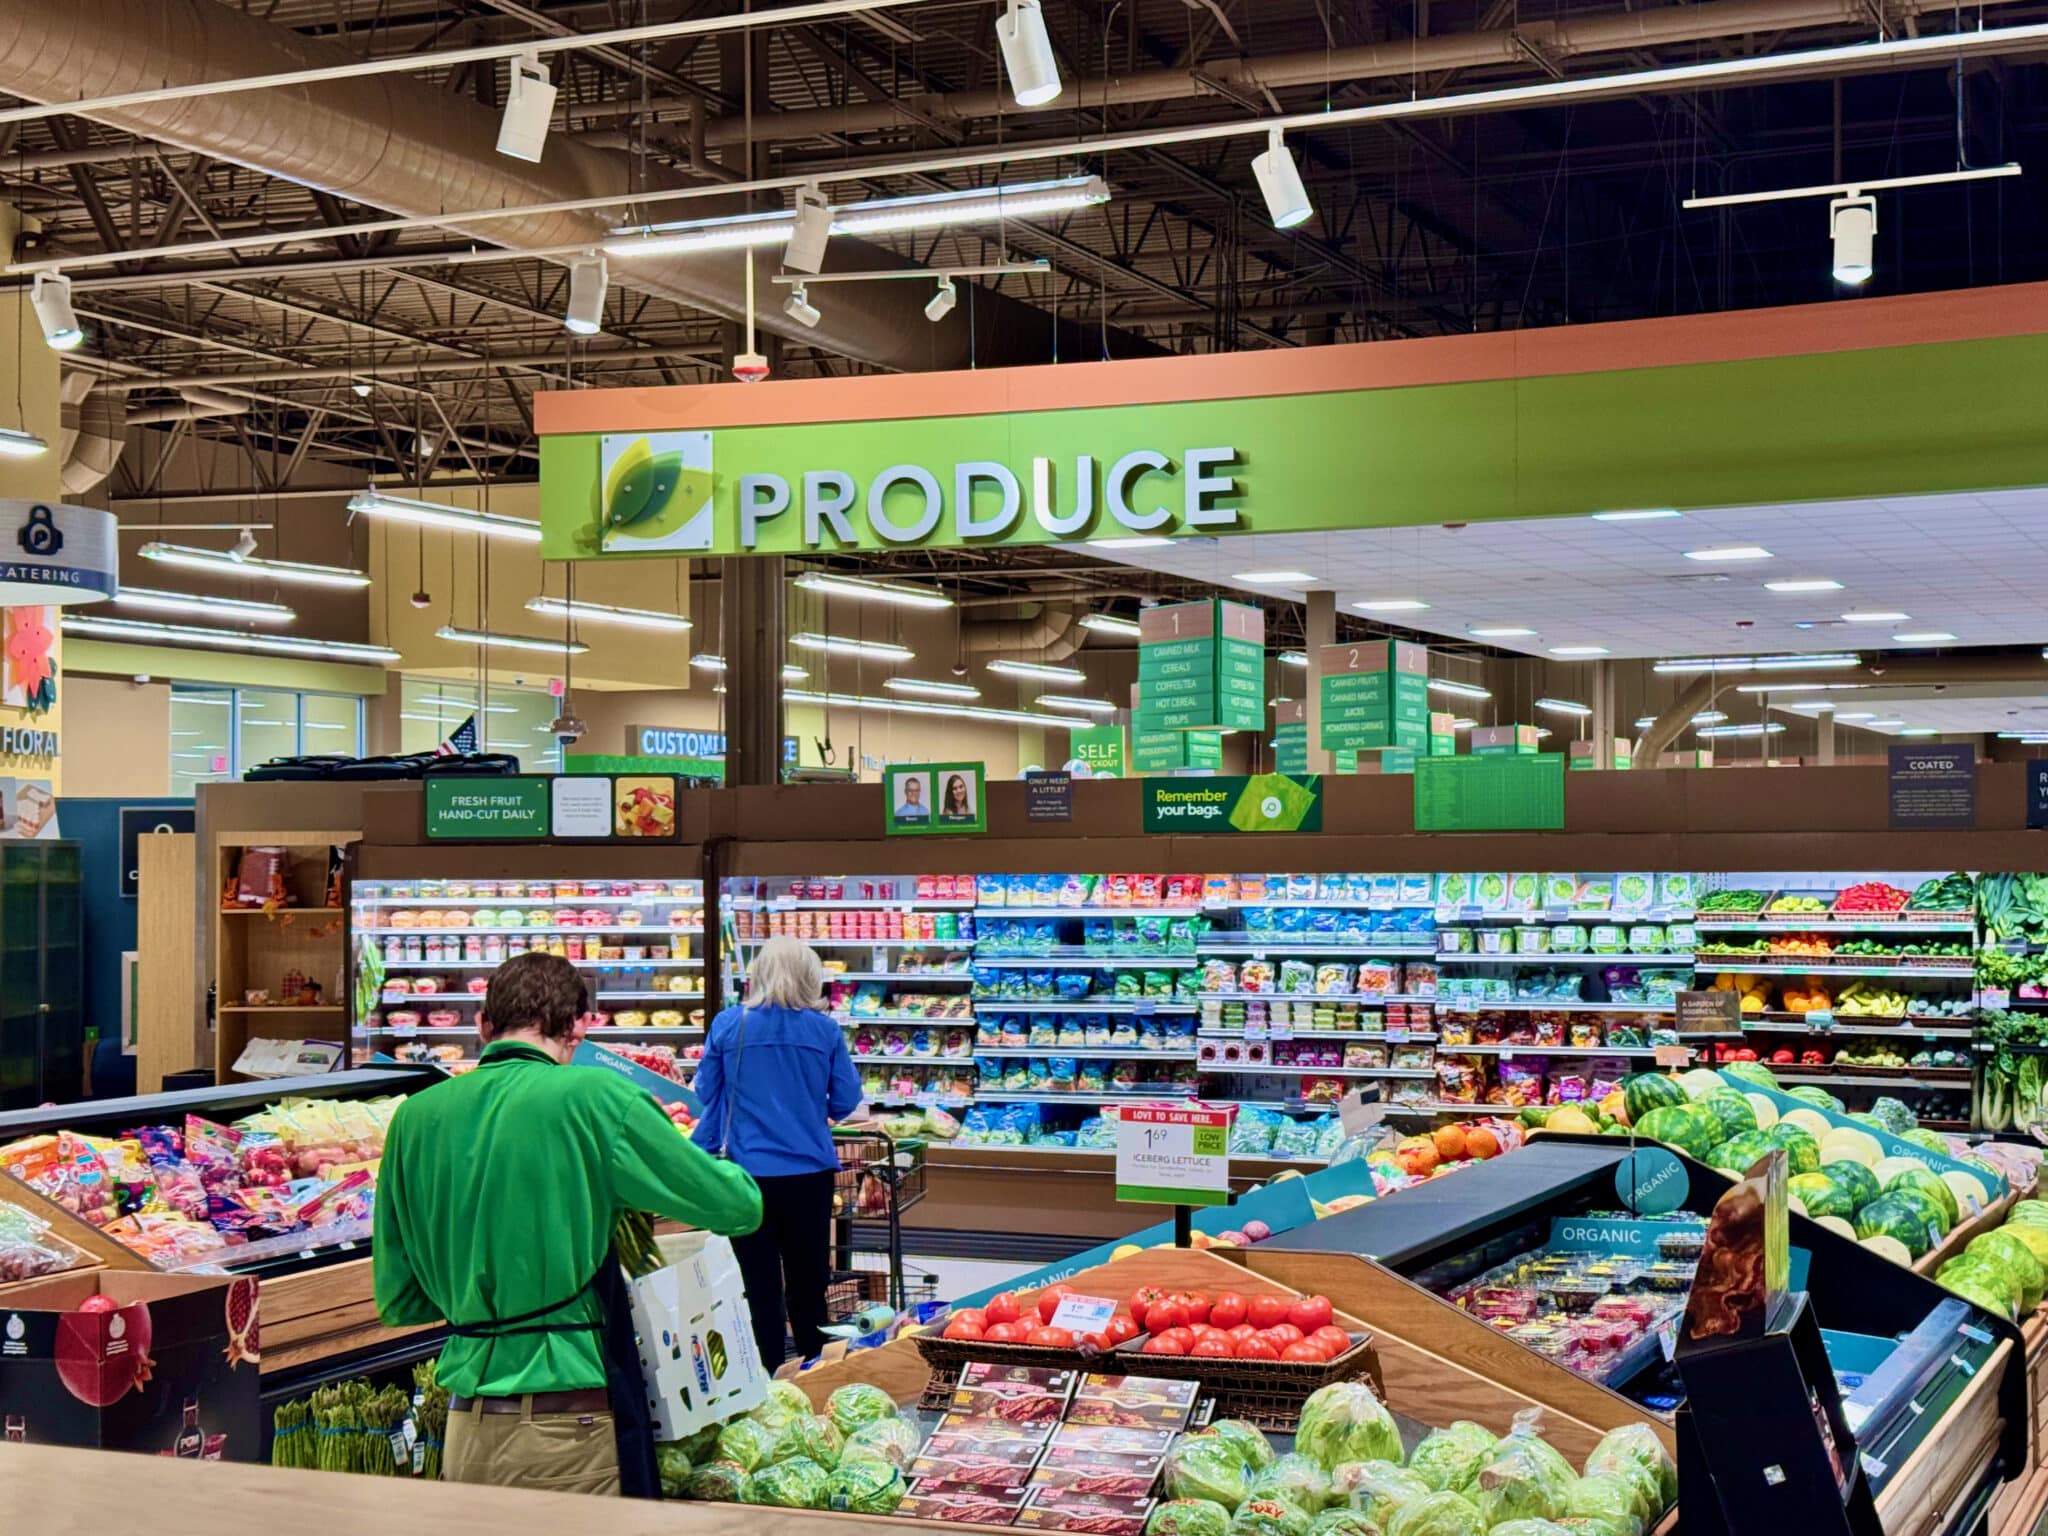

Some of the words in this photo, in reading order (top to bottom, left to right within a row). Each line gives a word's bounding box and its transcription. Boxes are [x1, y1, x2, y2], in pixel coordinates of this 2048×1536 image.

[740, 446, 1238, 548] PRODUCE
[0, 566, 80, 584] ATERING
[1171, 611, 1180, 636] 1
[1349, 648, 1359, 669] 2
[1161, 662, 1191, 673] CEREALS
[1155, 697, 1169, 709] HOT
[1295, 703, 1303, 719] 4
[3, 726, 60, 757] FLORAL
[1489, 729, 1497, 743] 6
[1078, 743, 1118, 759] SELF
[1909, 760, 1954, 770] COATED
[451, 796, 488, 807] FRESH
[489, 795, 523, 807] FRUIT
[1156, 789, 1228, 802] Remember
[438, 808, 501, 820] HAND-CUT
[502, 808, 536, 820] DAILY
[1156, 804, 1187, 820] your
[1187, 803, 1223, 819] bags.
[595, 1052, 635, 1076] ORGANIC
[1132, 1109, 1152, 1120] LOVE
[1155, 1111, 1166, 1121] TO
[1168, 1111, 1188, 1123] SAVE
[1191, 1113, 1213, 1124] HERE.
[1199, 1132, 1220, 1142] LOW
[1197, 1141, 1222, 1150] PRICE
[1133, 1153, 1170, 1164] ICEBERG
[1172, 1155, 1211, 1167] LETTUCE
[1562, 1226, 1642, 1244] ORGANIC
